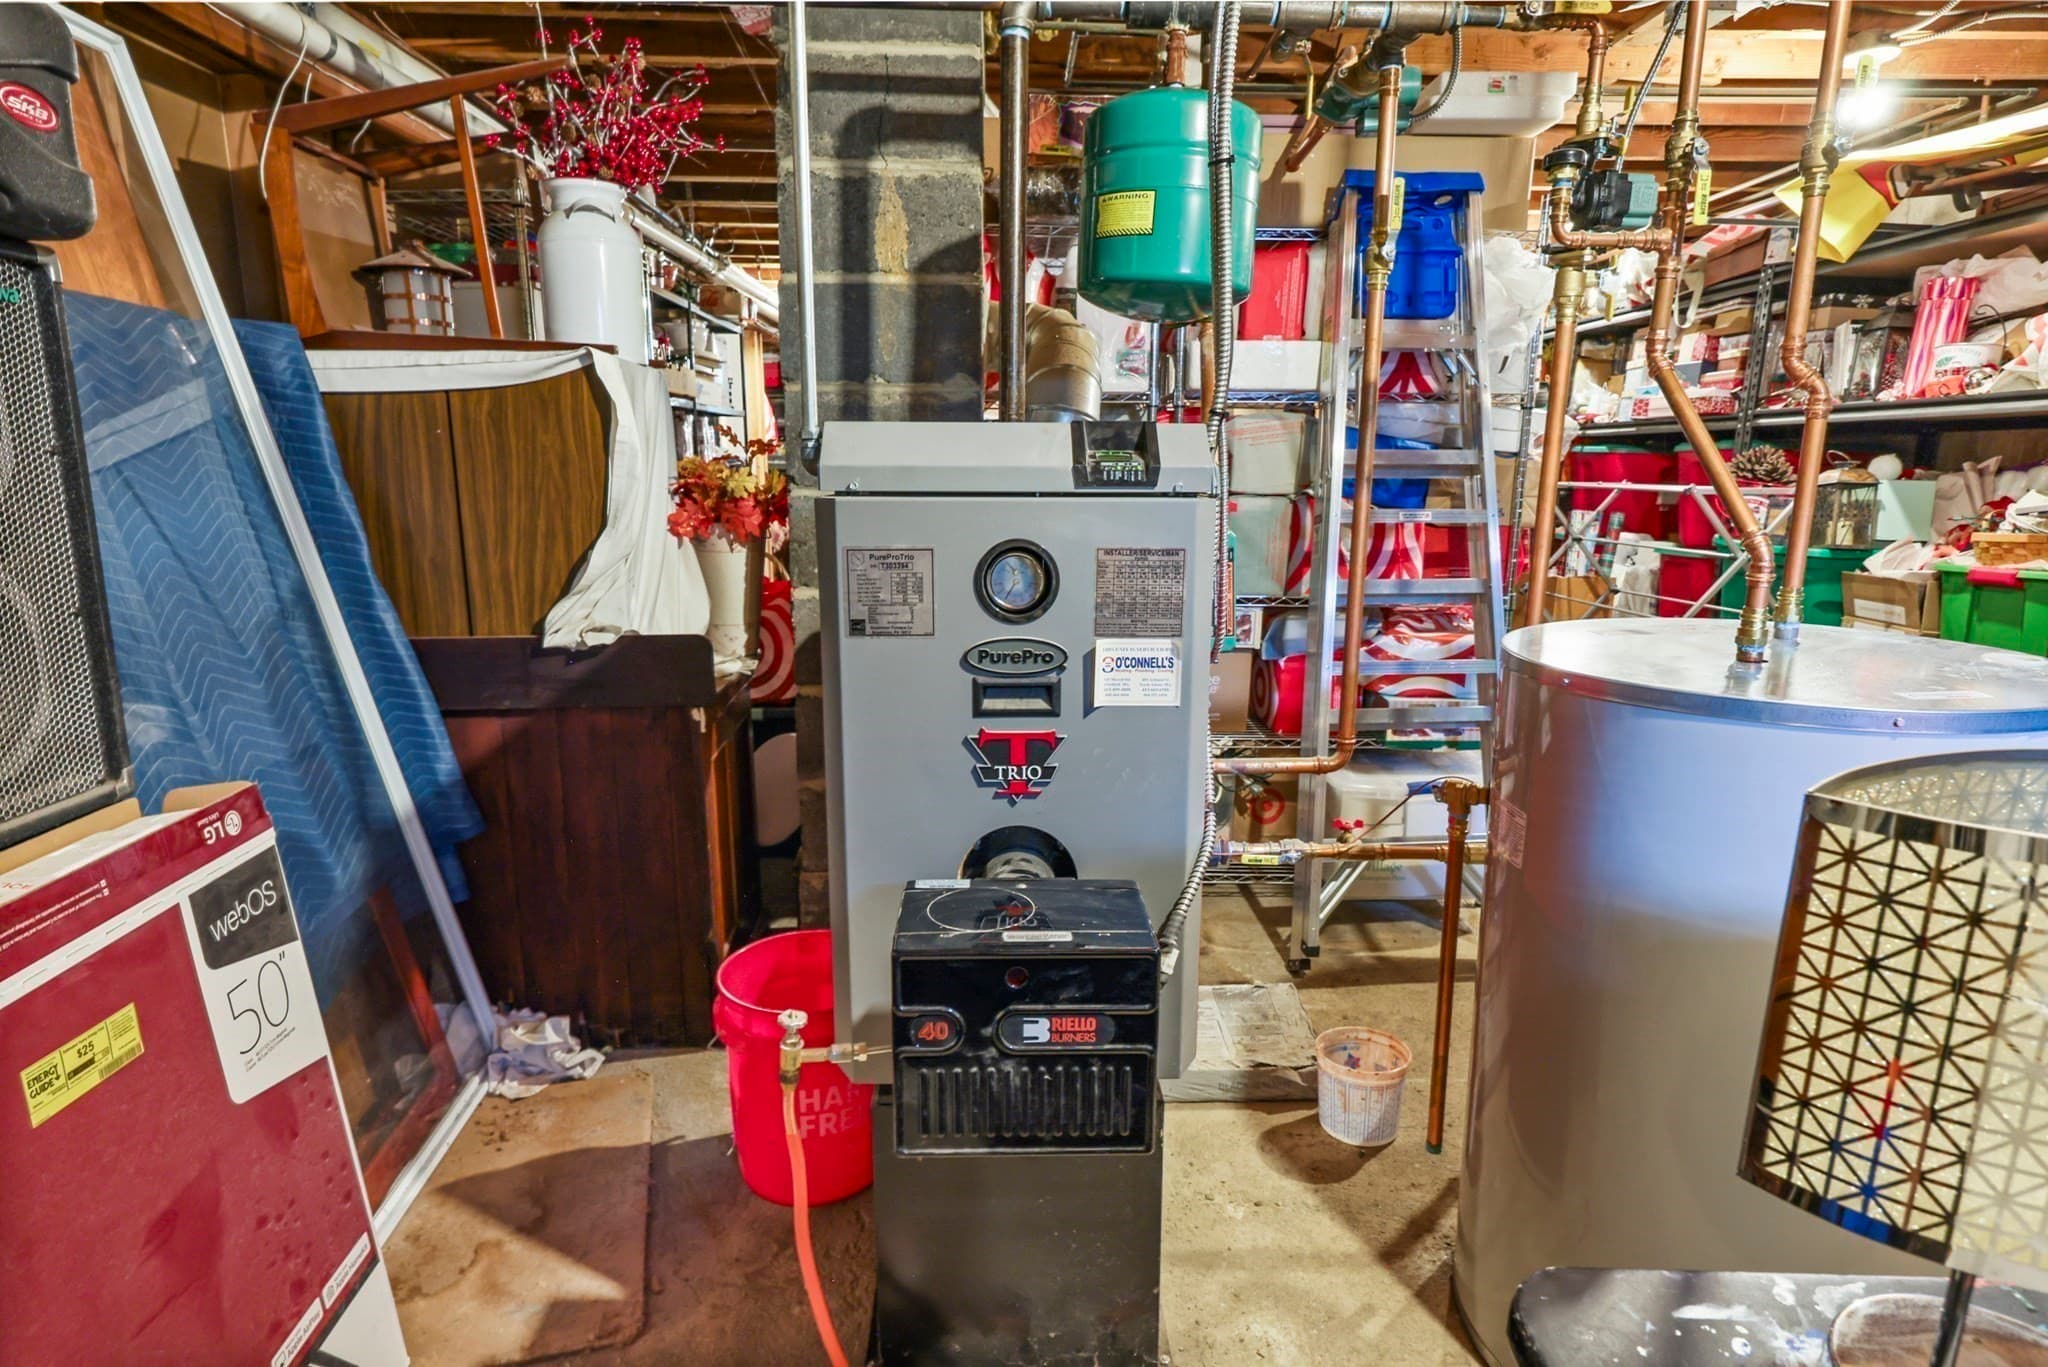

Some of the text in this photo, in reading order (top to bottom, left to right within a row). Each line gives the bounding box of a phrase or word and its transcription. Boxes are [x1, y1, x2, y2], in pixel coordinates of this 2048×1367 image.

[7, 95, 49, 121] SKB
[977, 649, 1055, 665] PurePro
[1115, 656, 1175, 669] O'CONNELL'S
[994, 765, 1042, 781] TRIO
[203, 822, 225, 845] LG
[209, 879, 277, 942] webOS
[917, 1021, 950, 1041] 40
[1051, 1016, 1097, 1032] RIELLO
[1051, 1031, 1097, 1043] BURNERS
[76, 1040, 95, 1059] $25
[26, 1063, 60, 1090] ENERGY
[29, 1078, 57, 1100] GUIDE
